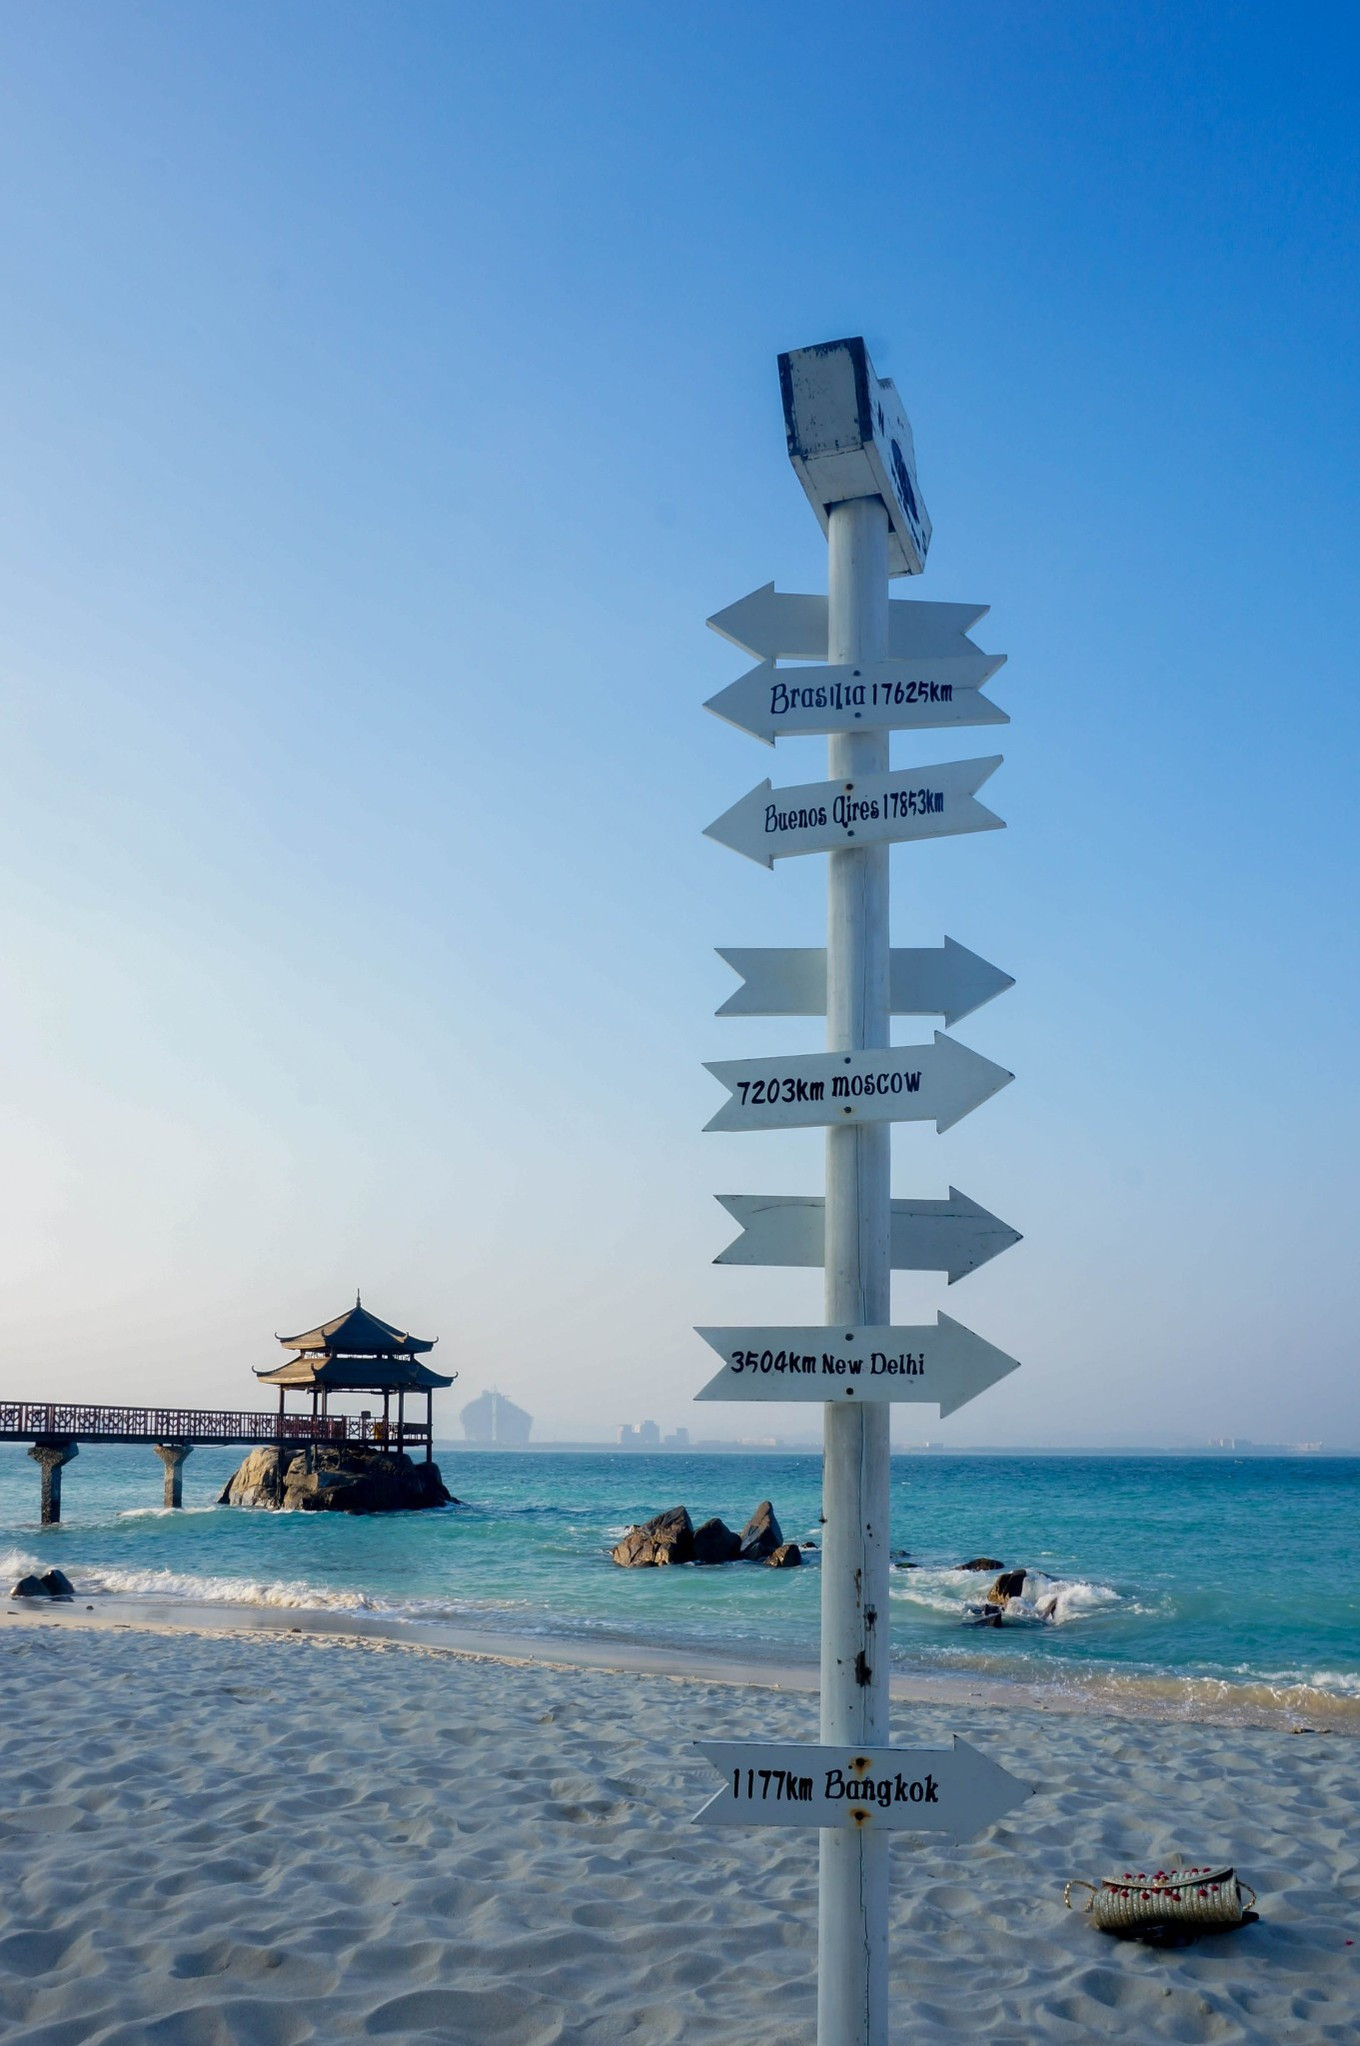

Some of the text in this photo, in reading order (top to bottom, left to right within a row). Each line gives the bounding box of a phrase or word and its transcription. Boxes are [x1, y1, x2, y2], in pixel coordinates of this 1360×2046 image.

[872, 680, 953, 706] 17625km
[764, 803, 828, 833] Buenos
[883, 788, 945, 820] 17853km
[736, 1077, 825, 1105] 7203km
[730, 1350, 925, 1375] 3504km New Delhi
[732, 1768, 939, 1807] 1177km Bangkok
